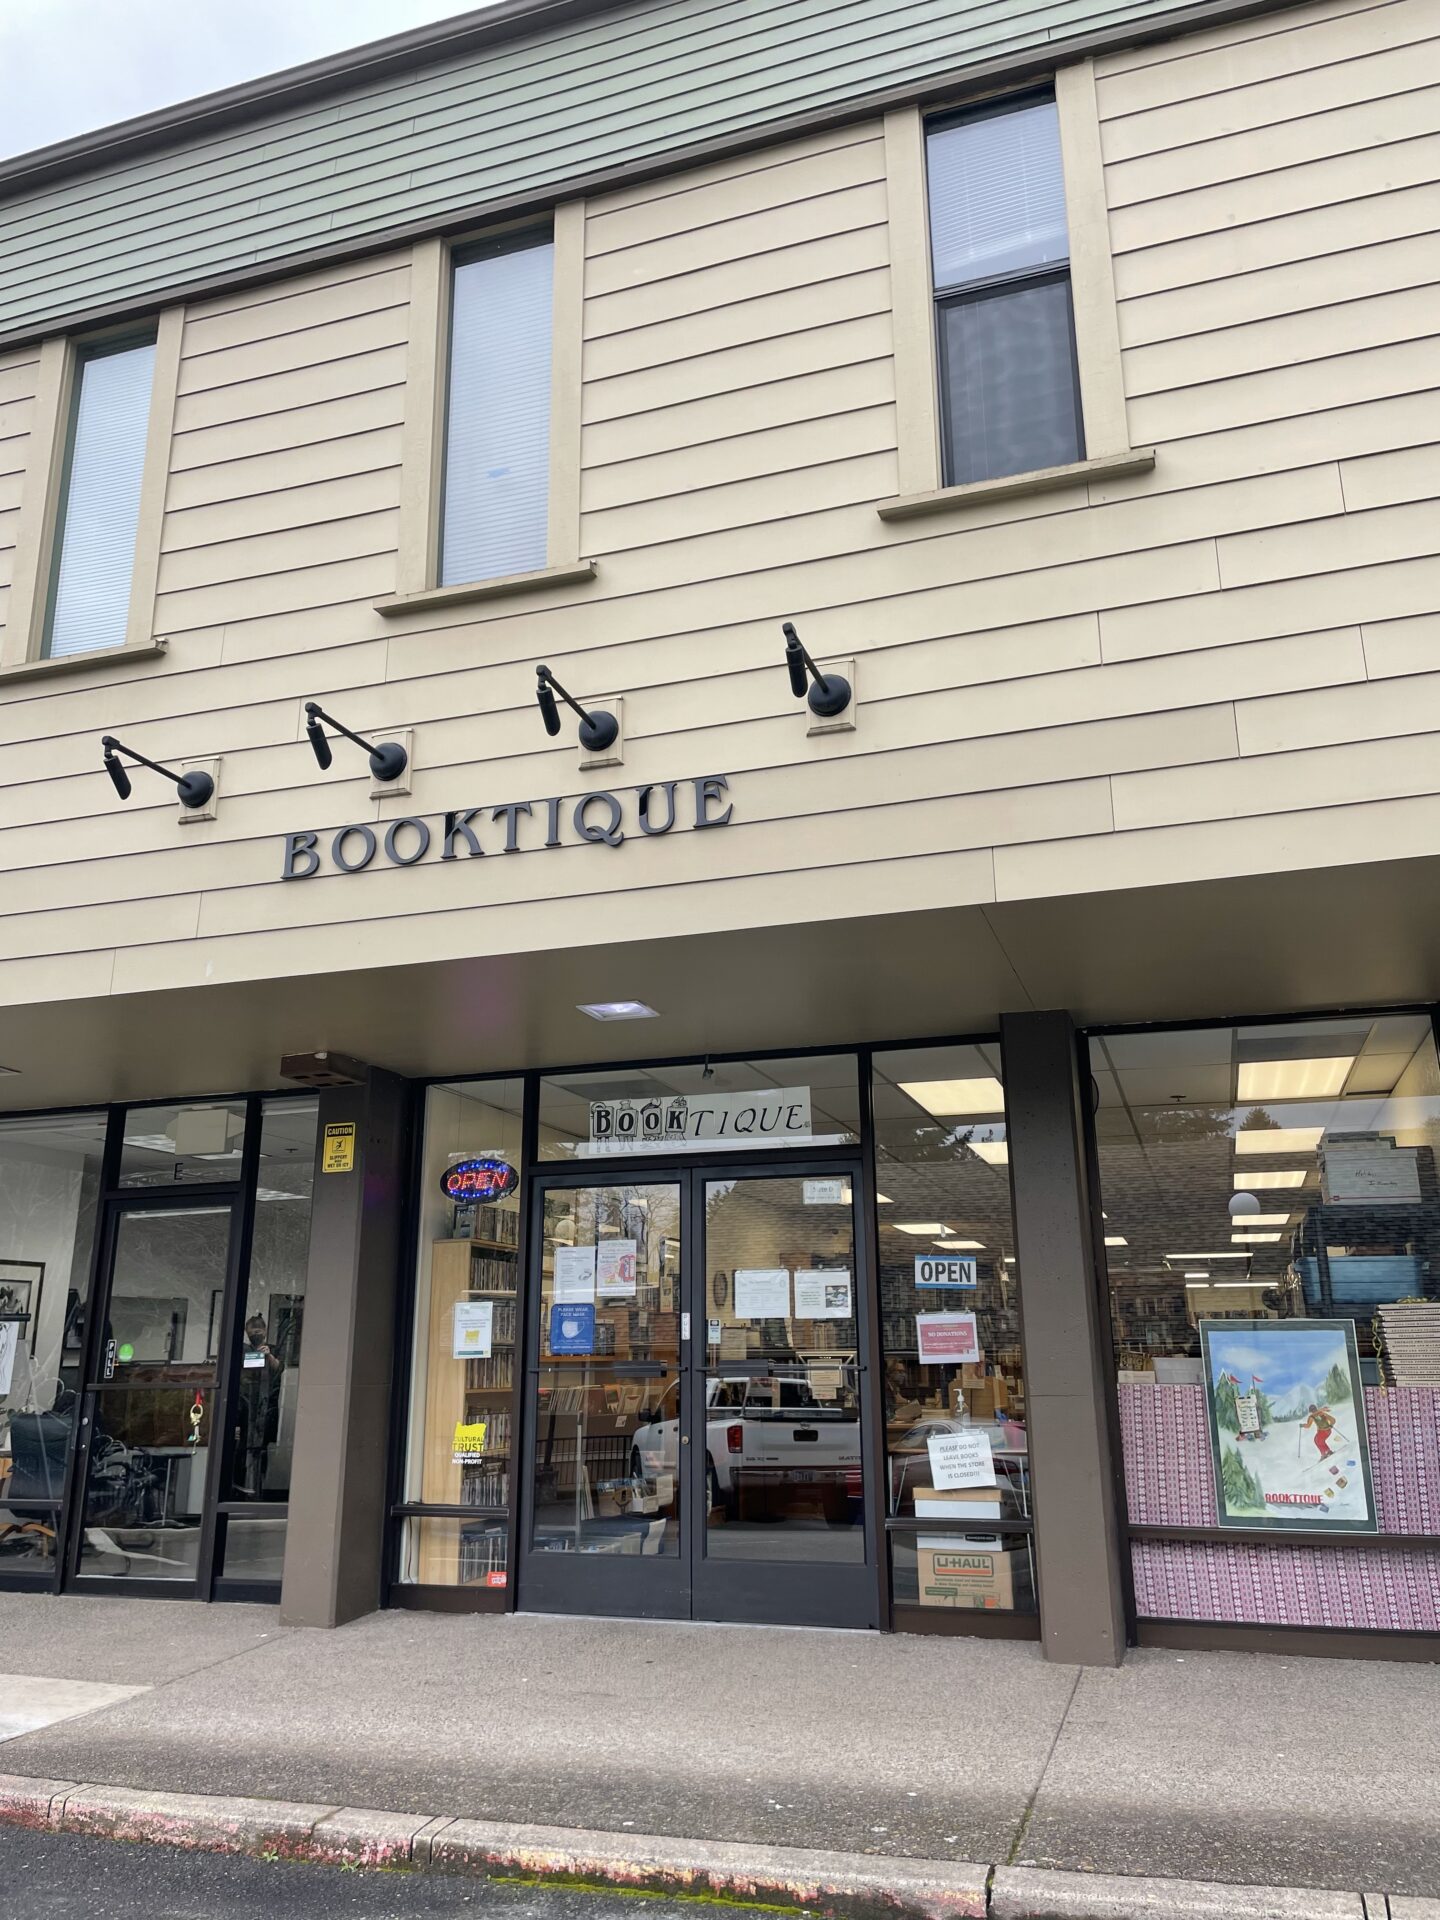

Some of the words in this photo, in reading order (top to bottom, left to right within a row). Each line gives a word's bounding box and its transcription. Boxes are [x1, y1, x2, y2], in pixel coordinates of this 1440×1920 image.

[280, 775, 734, 881] BOOKTIQUE
[595, 1104, 804, 1137] BOOKTIQUE
[328, 1127, 353, 1135] CAUTION
[174, 1162, 184, 1180] E
[447, 1171, 508, 1190] OPEN
[921, 1262, 971, 1282] OPEN
[106, 1342, 115, 1376] PULL
[453, 1443, 484, 1452] TRUST
[936, 1557, 990, 1569] U-HAUL
